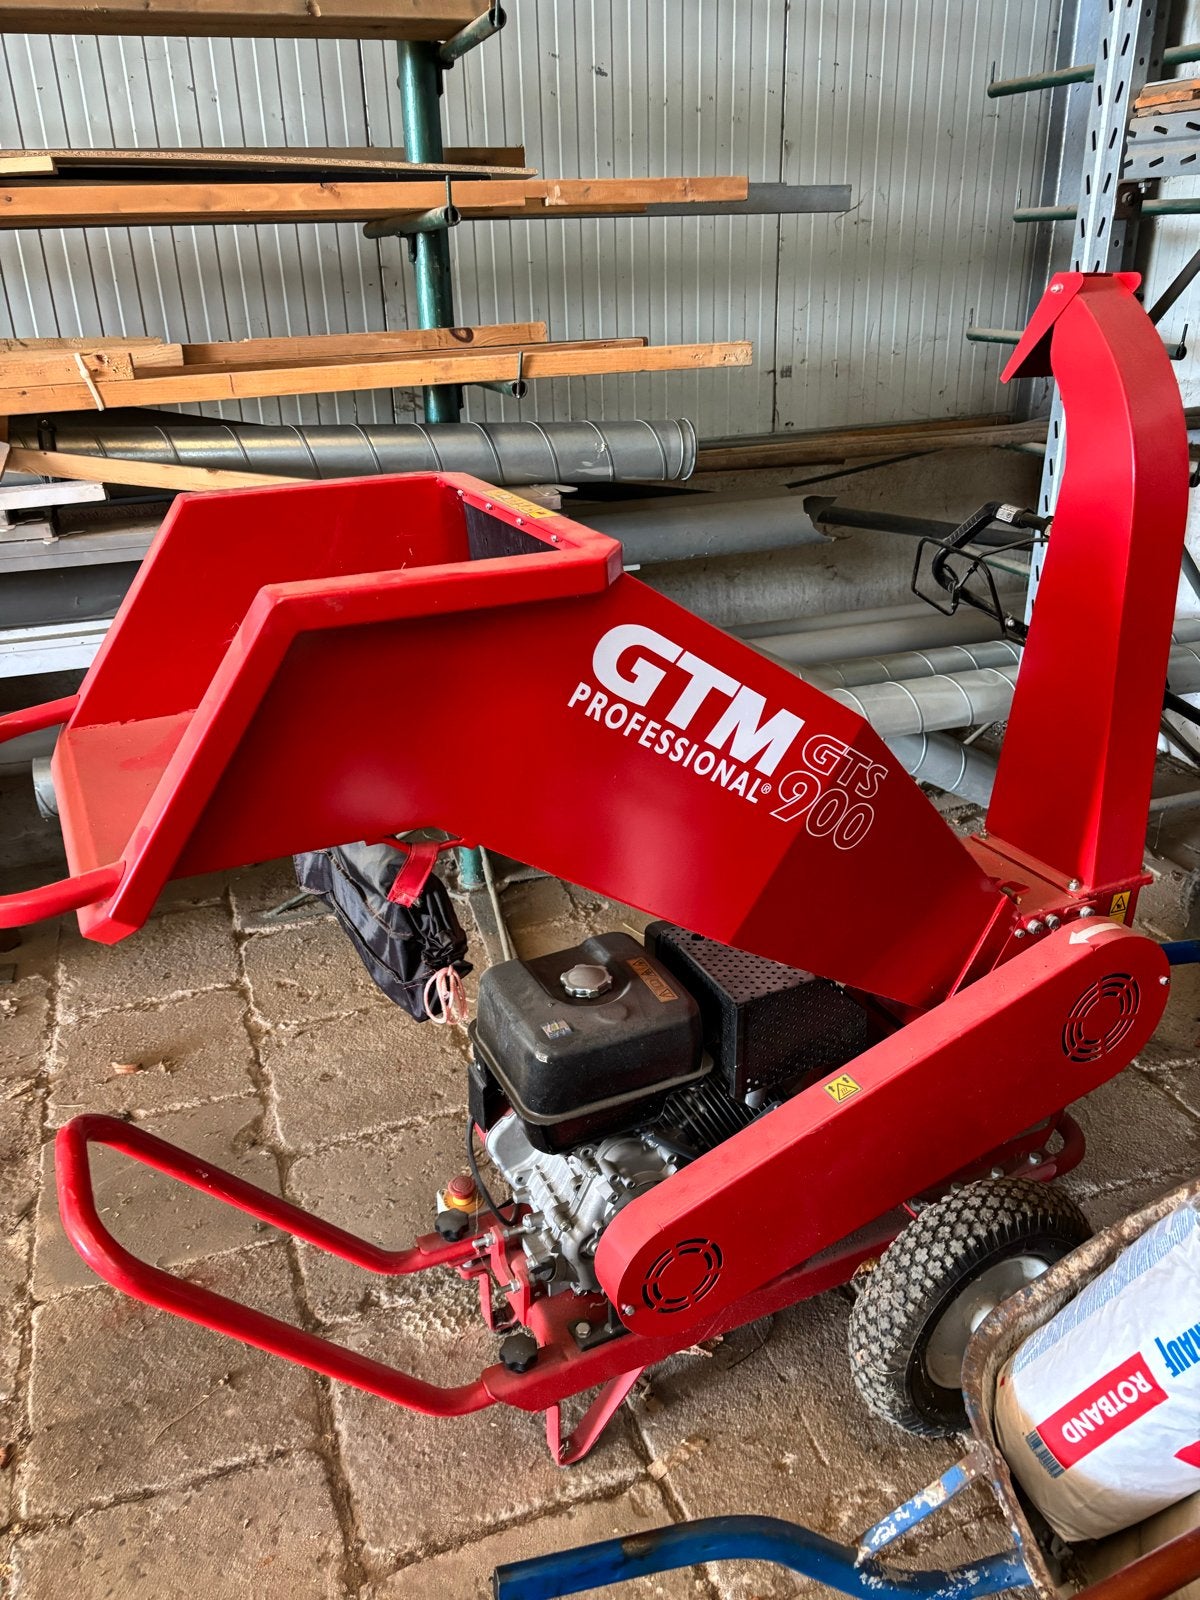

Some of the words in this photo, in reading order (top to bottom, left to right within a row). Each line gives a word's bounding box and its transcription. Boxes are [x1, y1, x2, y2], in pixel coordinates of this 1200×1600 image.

[592, 623, 806, 778] GTM
[801, 734, 889, 799] GTS
[769, 770, 875, 850] 900
[1061, 1371, 1153, 1444] ROTBAND
